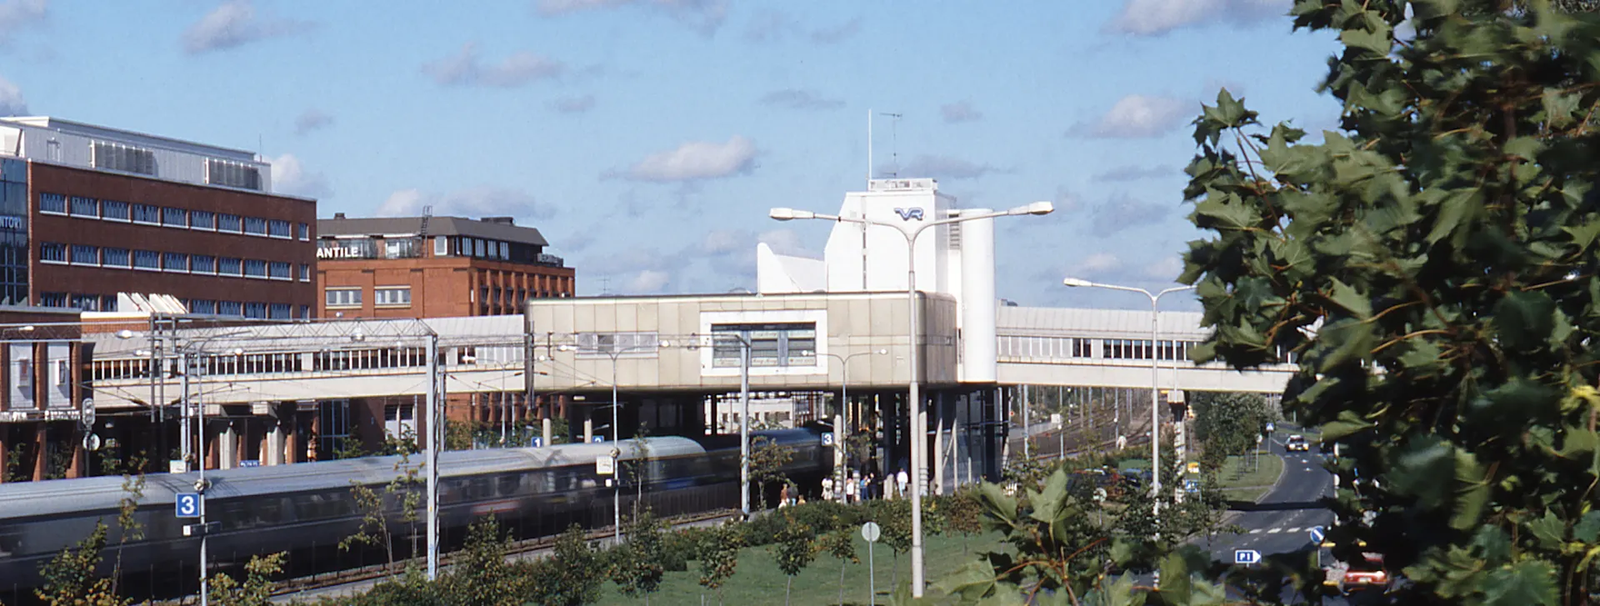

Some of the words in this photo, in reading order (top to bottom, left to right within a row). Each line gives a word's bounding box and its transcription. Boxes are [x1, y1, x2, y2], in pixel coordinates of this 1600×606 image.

[894, 207, 924, 221] VR
[316, 247, 359, 258] ANTILE
[534, 438, 541, 448] 1
[824, 434, 833, 445] 3
[181, 496, 195, 515] 3
